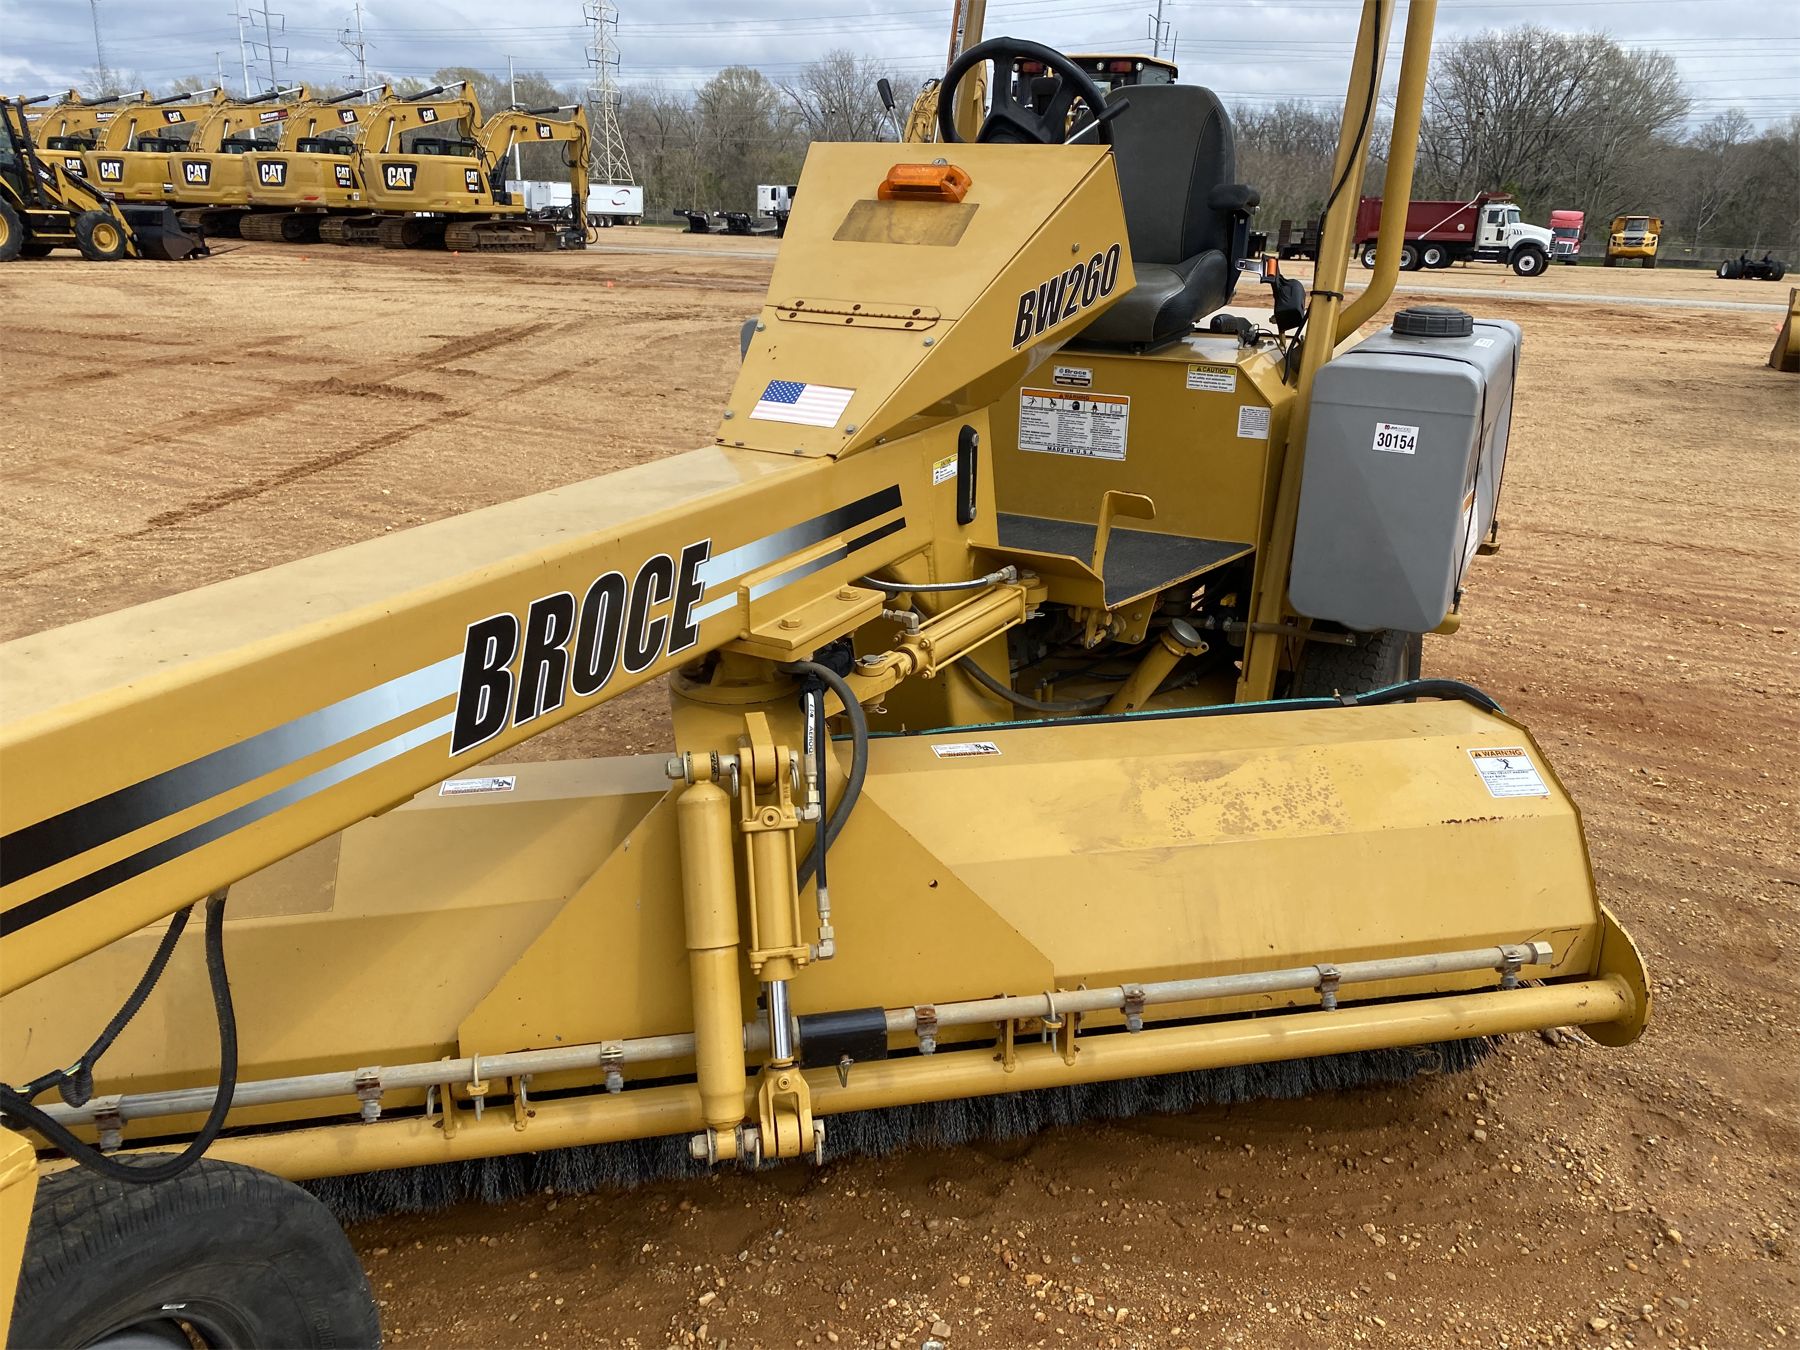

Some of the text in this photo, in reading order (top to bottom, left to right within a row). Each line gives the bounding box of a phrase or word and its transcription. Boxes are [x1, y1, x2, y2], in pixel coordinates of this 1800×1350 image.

[168, 111, 181, 122] CAT
[342, 111, 354, 122] CAT
[422, 109, 435, 122] CAT
[539, 124, 550, 138] CAT
[66, 158, 81, 169] CAT
[101, 162, 120, 179] CAT
[186, 164, 207, 182] CAT
[261, 164, 283, 183] CAT
[336, 166, 350, 179] CAT
[387, 166, 413, 187] CAT
[466, 170, 478, 183] CAT
[1011, 242, 1121, 350] BW260
[1377, 432, 1415, 451] 30154
[449, 537, 712, 758] BROCE
[1482, 749, 1522, 757] WARNING
